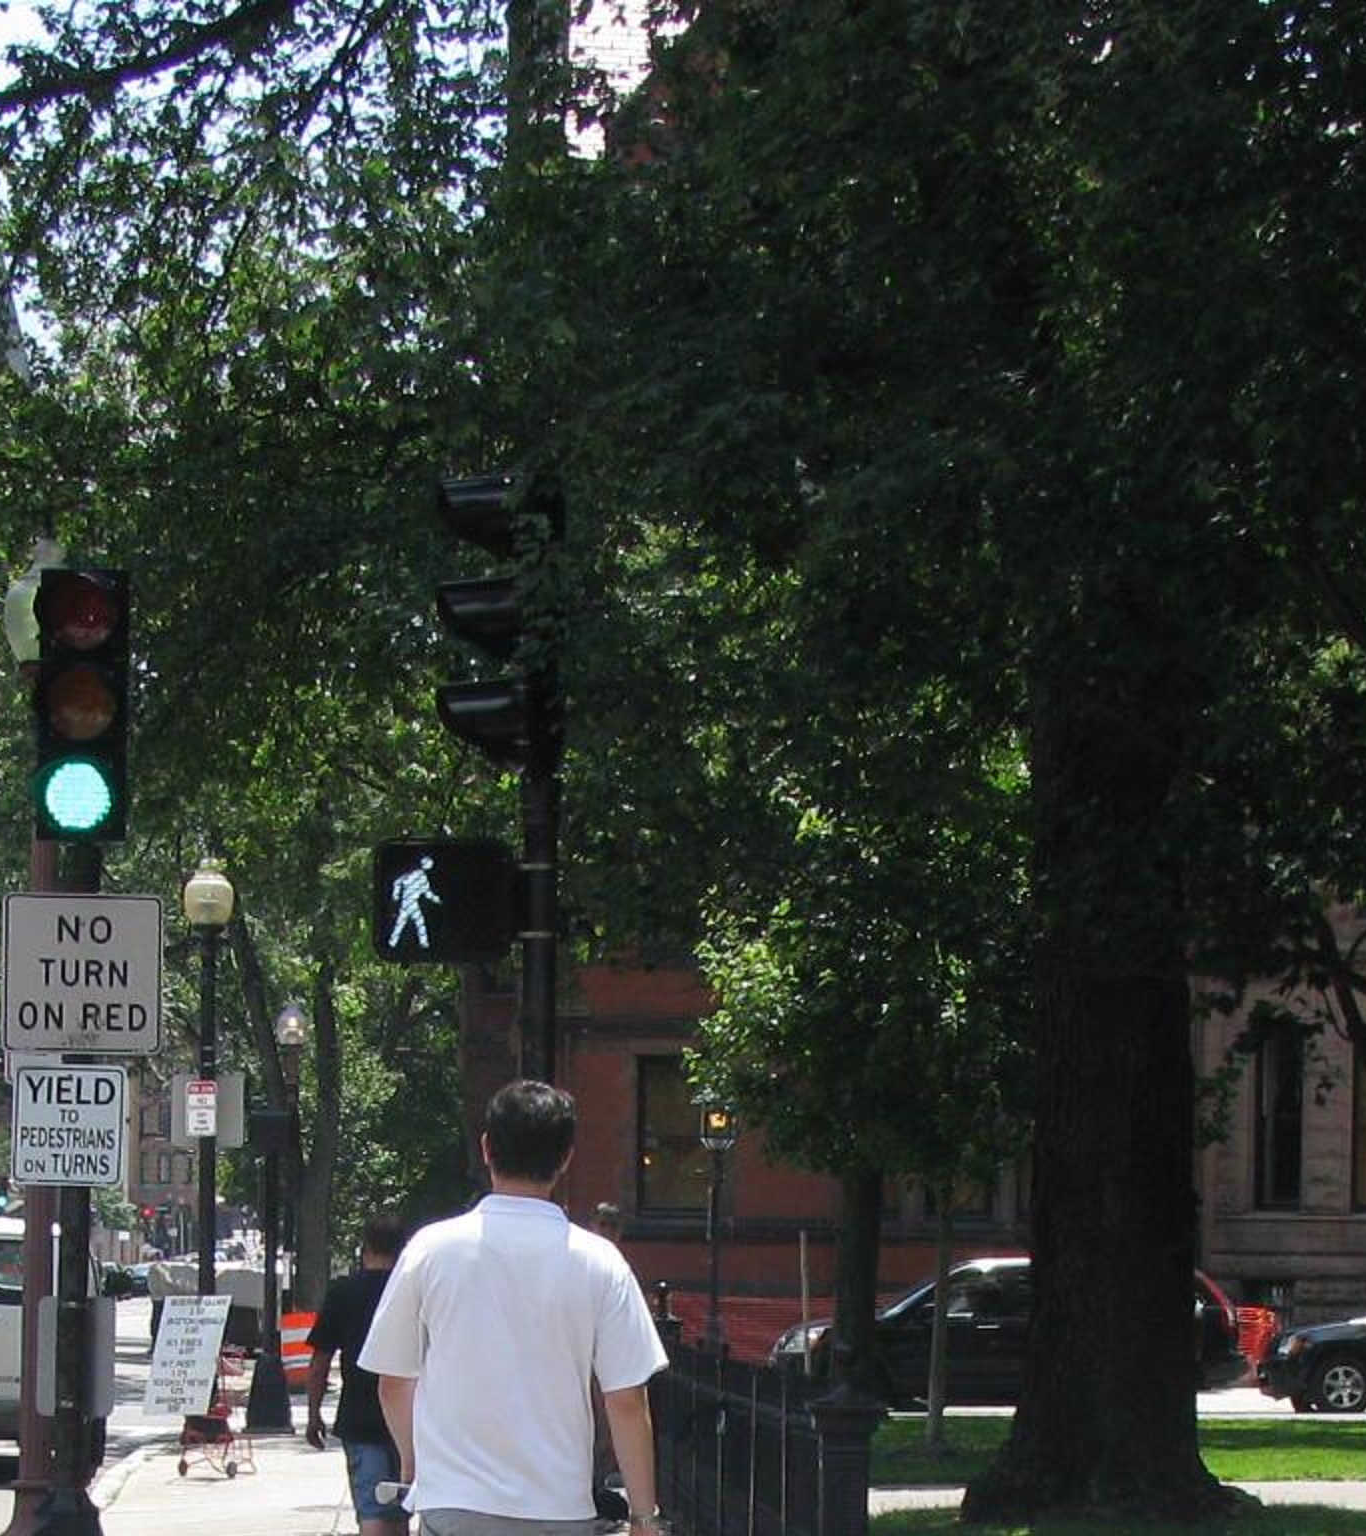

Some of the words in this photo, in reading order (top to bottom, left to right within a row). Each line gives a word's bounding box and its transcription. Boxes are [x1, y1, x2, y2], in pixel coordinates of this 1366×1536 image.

[57, 914, 112, 945] NO
[38, 958, 128, 988] TURN
[18, 1001, 64, 1031] ON
[82, 1003, 147, 1032] RED
[26, 1075, 116, 1105] YIELD
[59, 1109, 80, 1123] TO
[20, 1126, 115, 1150] PEDESTRIANS
[24, 1159, 46, 1173] ON
[51, 1153, 110, 1177] TURNS
